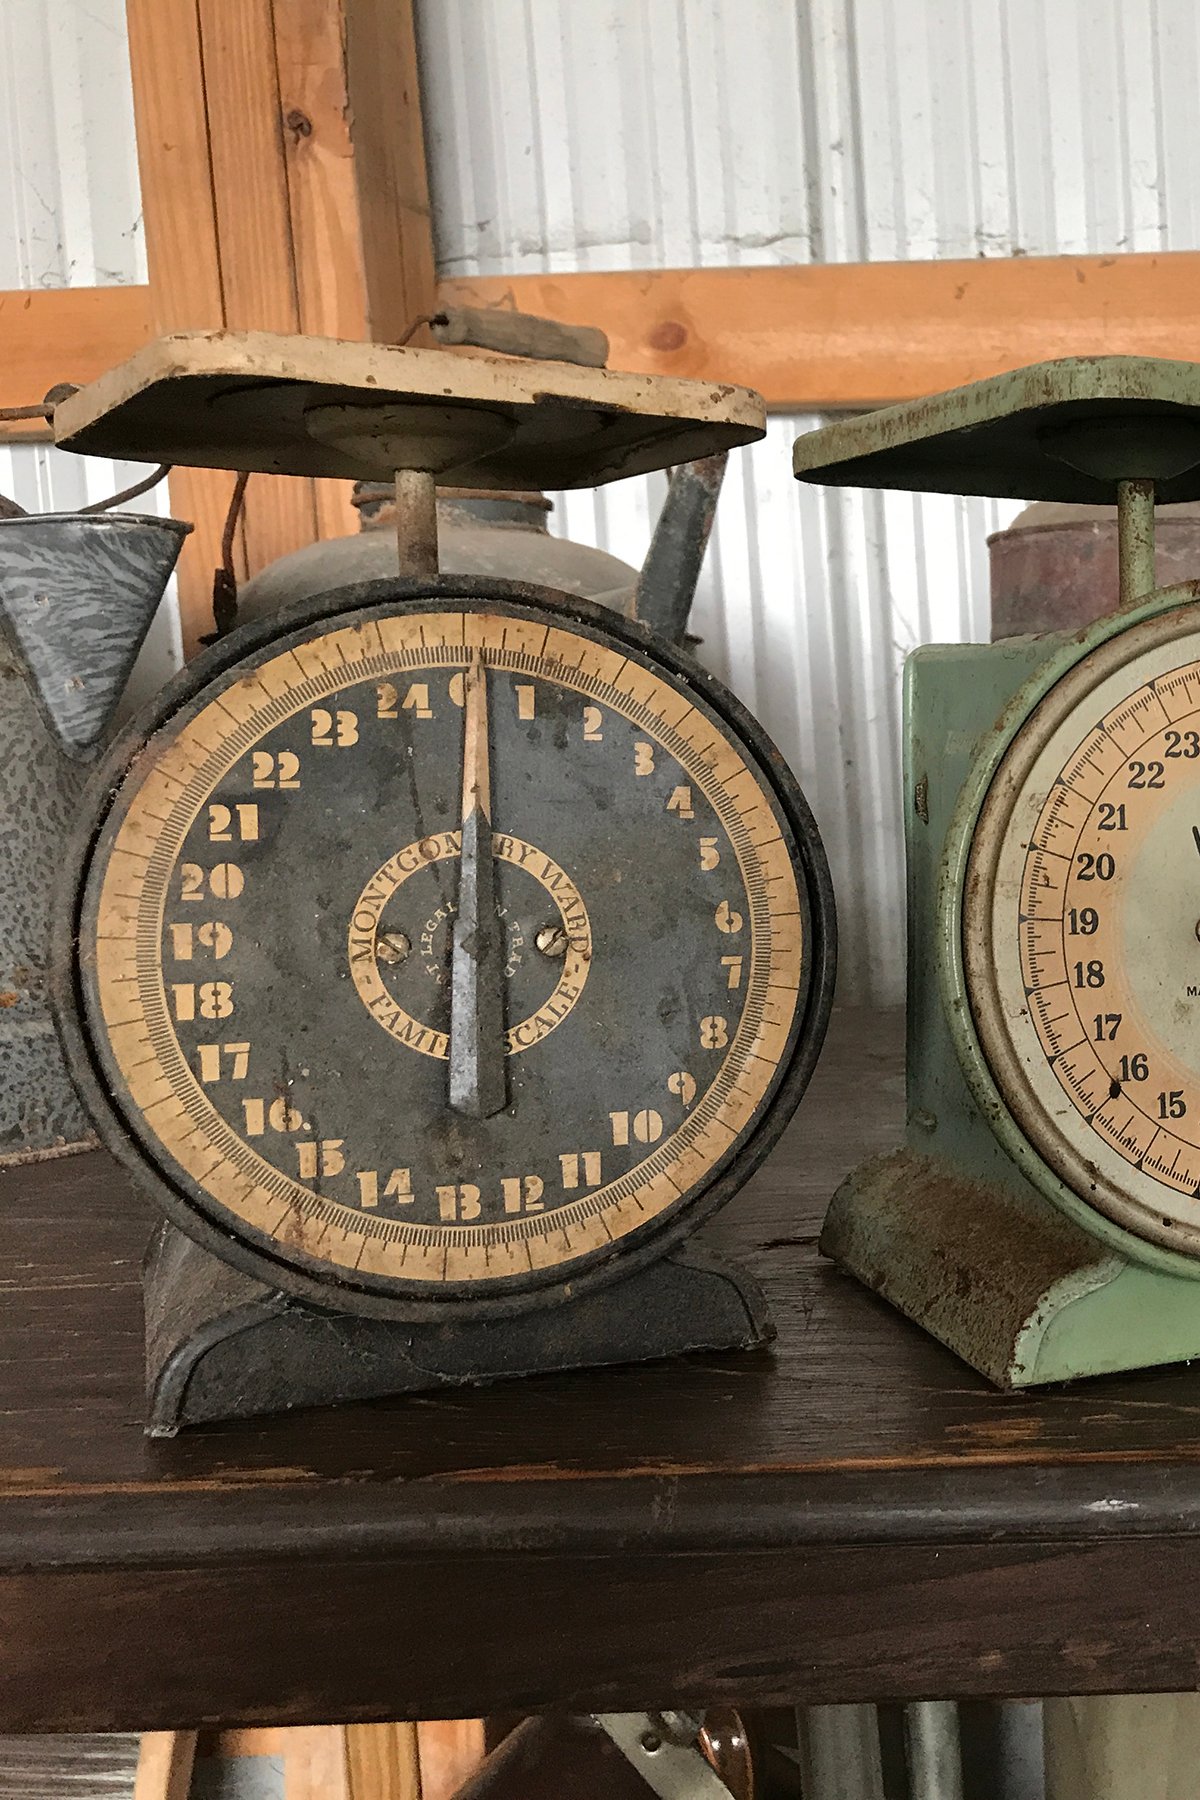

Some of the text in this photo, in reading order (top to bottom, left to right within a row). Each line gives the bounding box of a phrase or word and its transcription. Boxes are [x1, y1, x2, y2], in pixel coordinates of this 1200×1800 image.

[378, 683, 432, 719] 24
[518, 684, 535, 719] 1
[312, 710, 359, 746] 23
[583, 708, 603, 741] 2
[634, 742, 654, 776] 3
[1165, 731, 1200, 758] 23
[252, 752, 300, 789] 22
[1128, 762, 1165, 788] 22
[667, 786, 694, 819] 4
[1098, 804, 1128, 831] 21
[209, 804, 259, 841] 21
[699, 838, 719, 871] 5
[1077, 853, 1114, 880] 20
[181, 864, 244, 899] 20
[540, 860, 590, 953] WARD
[714, 902, 742, 933] 6
[1069, 908, 1098, 934] 19
[171, 922, 232, 959] 19
[504, 922, 524, 978] TRAD
[721, 956, 742, 989] 7
[1075, 962, 1104, 987] 18
[172, 983, 233, 1019] 18
[701, 1016, 728, 1048] 8
[1094, 1014, 1122, 1040] 17
[199, 1042, 250, 1081] 17
[1120, 1055, 1149, 1081] 16
[668, 1071, 695, 1105] 9
[1158, 1091, 1186, 1118] 15
[243, 1099, 301, 1134] 16
[609, 1111, 662, 1144] 10
[296, 1140, 344, 1178] 15
[559, 1152, 601, 1187] 11
[358, 1169, 414, 1206] 14
[436, 1186, 481, 1220] 13
[502, 1176, 544, 1212] 12
